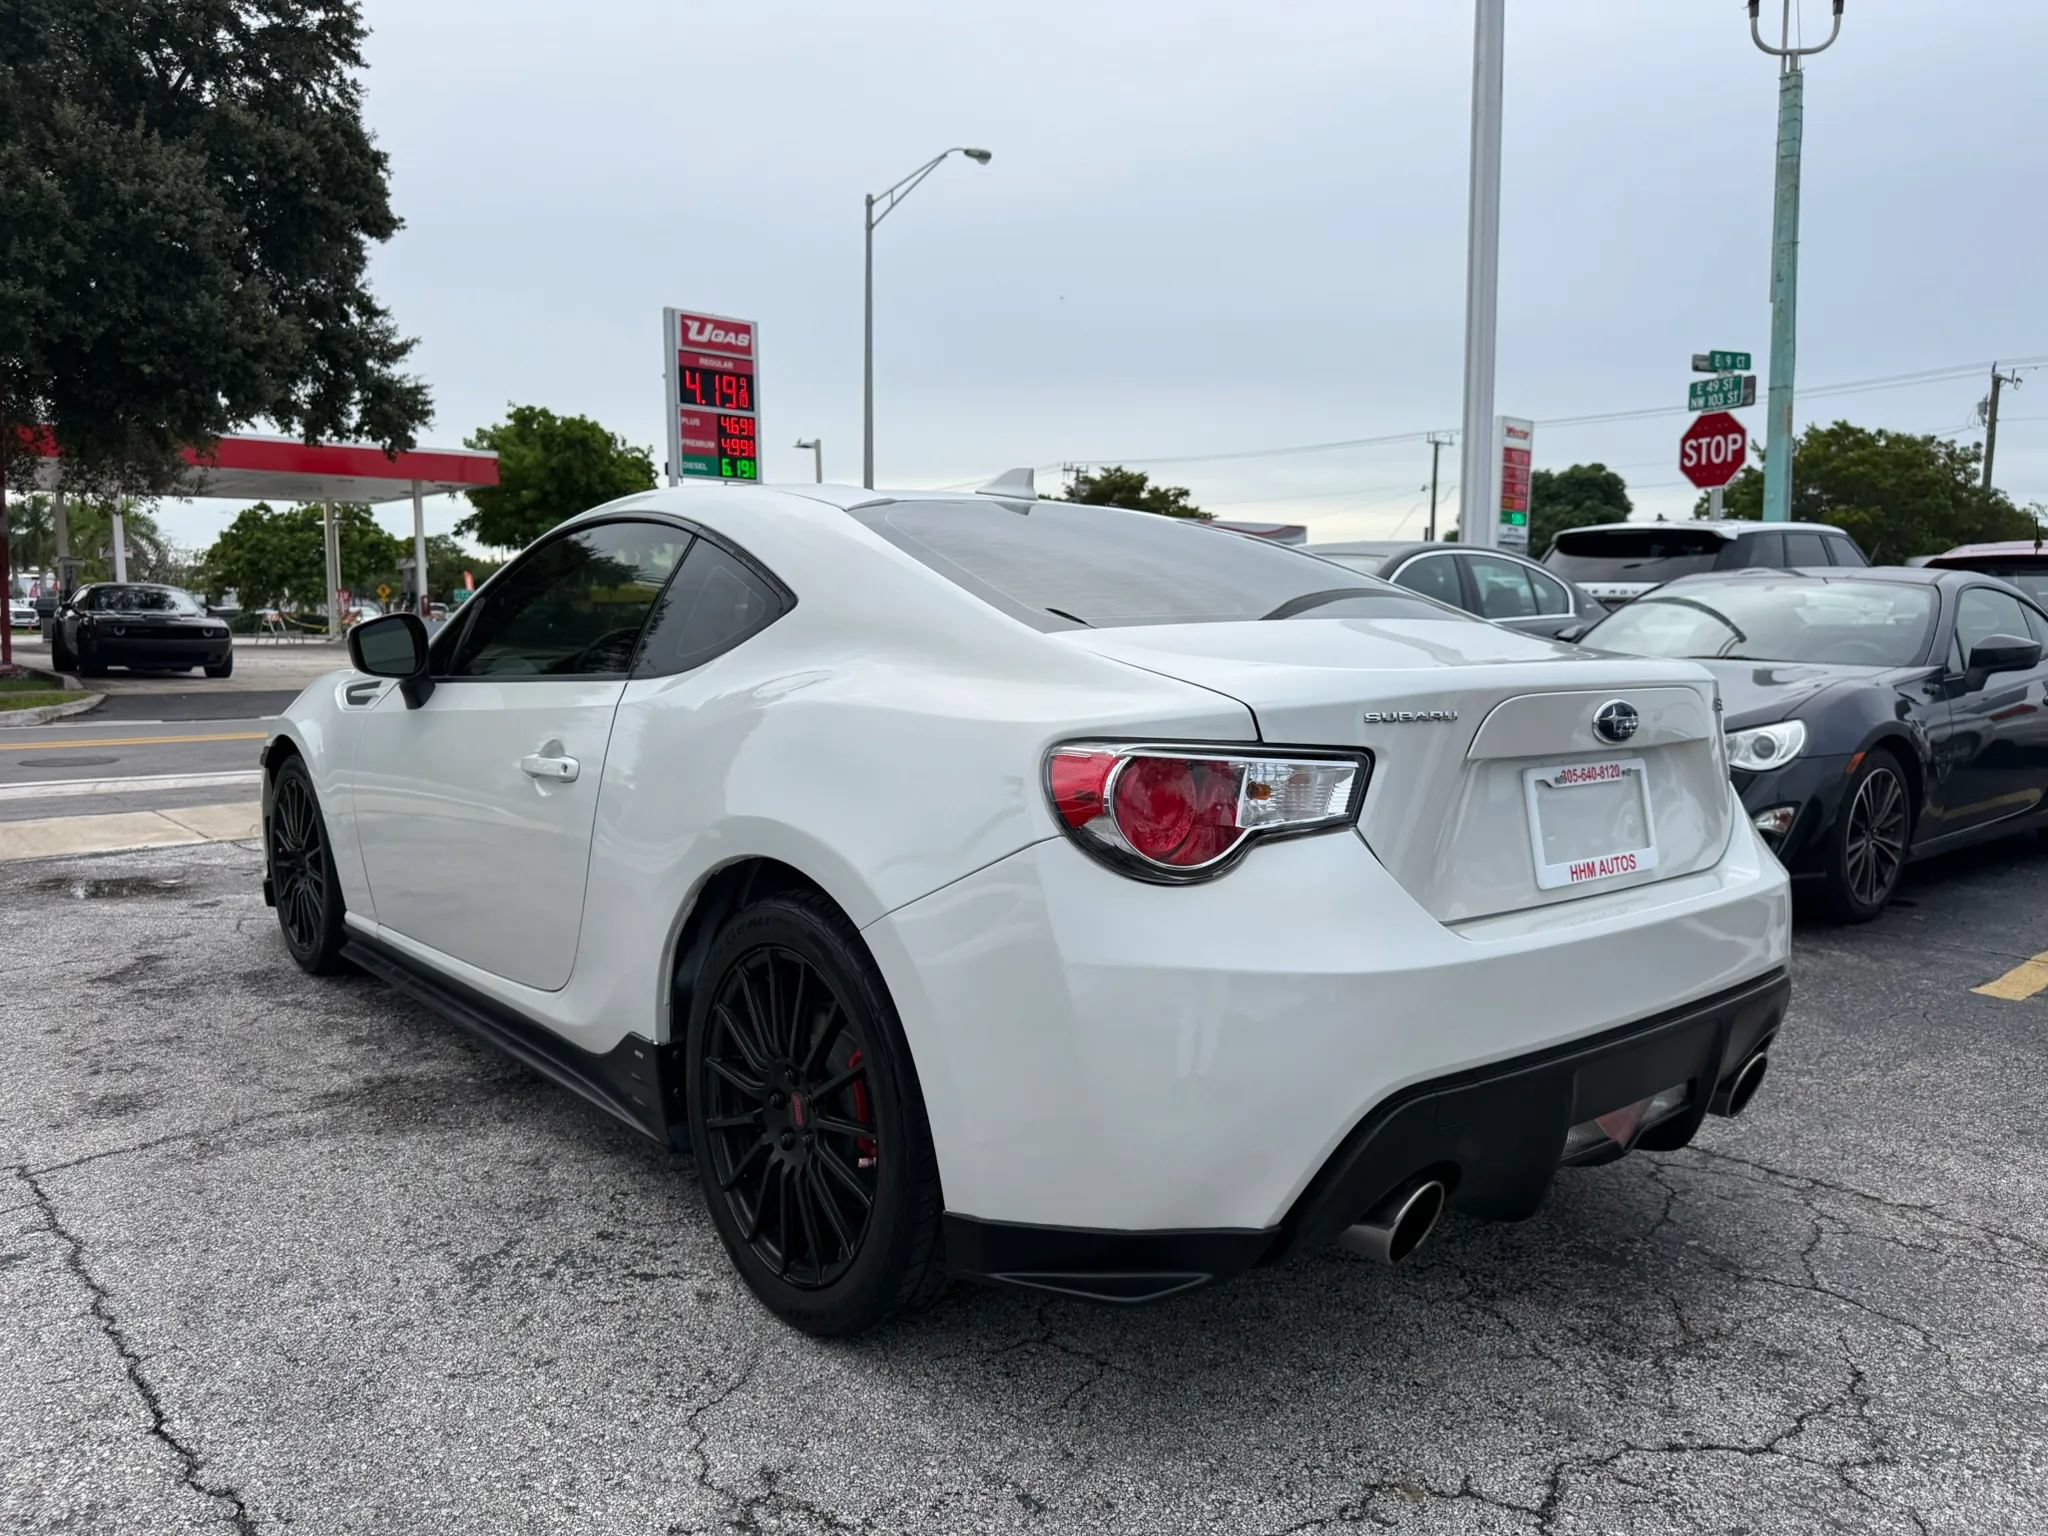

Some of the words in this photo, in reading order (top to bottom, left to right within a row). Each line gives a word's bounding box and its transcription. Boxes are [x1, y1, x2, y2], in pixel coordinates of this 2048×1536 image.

[699, 357, 734, 369] REGULAR
[1714, 354, 1721, 368] E
[1725, 355, 1732, 367] 9
[1736, 355, 1746, 369] CT
[685, 370, 737, 409] 4.19
[1696, 382, 1703, 395] E
[1706, 380, 1720, 394] 49
[1722, 377, 1735, 391] ST
[1691, 396, 1705, 410] NW
[1708, 393, 1723, 407] 103
[1727, 390, 1739, 404] ST
[681, 438, 716, 449] PREMIUM
[1683, 433, 1743, 468] STOP
[683, 461, 708, 471] DIESEL
[1364, 711, 1458, 723] SUBARU
[1560, 764, 1621, 784] 305-640-8120
[1569, 861, 1597, 881] HHM
[1599, 854, 1636, 876] AUTOS
